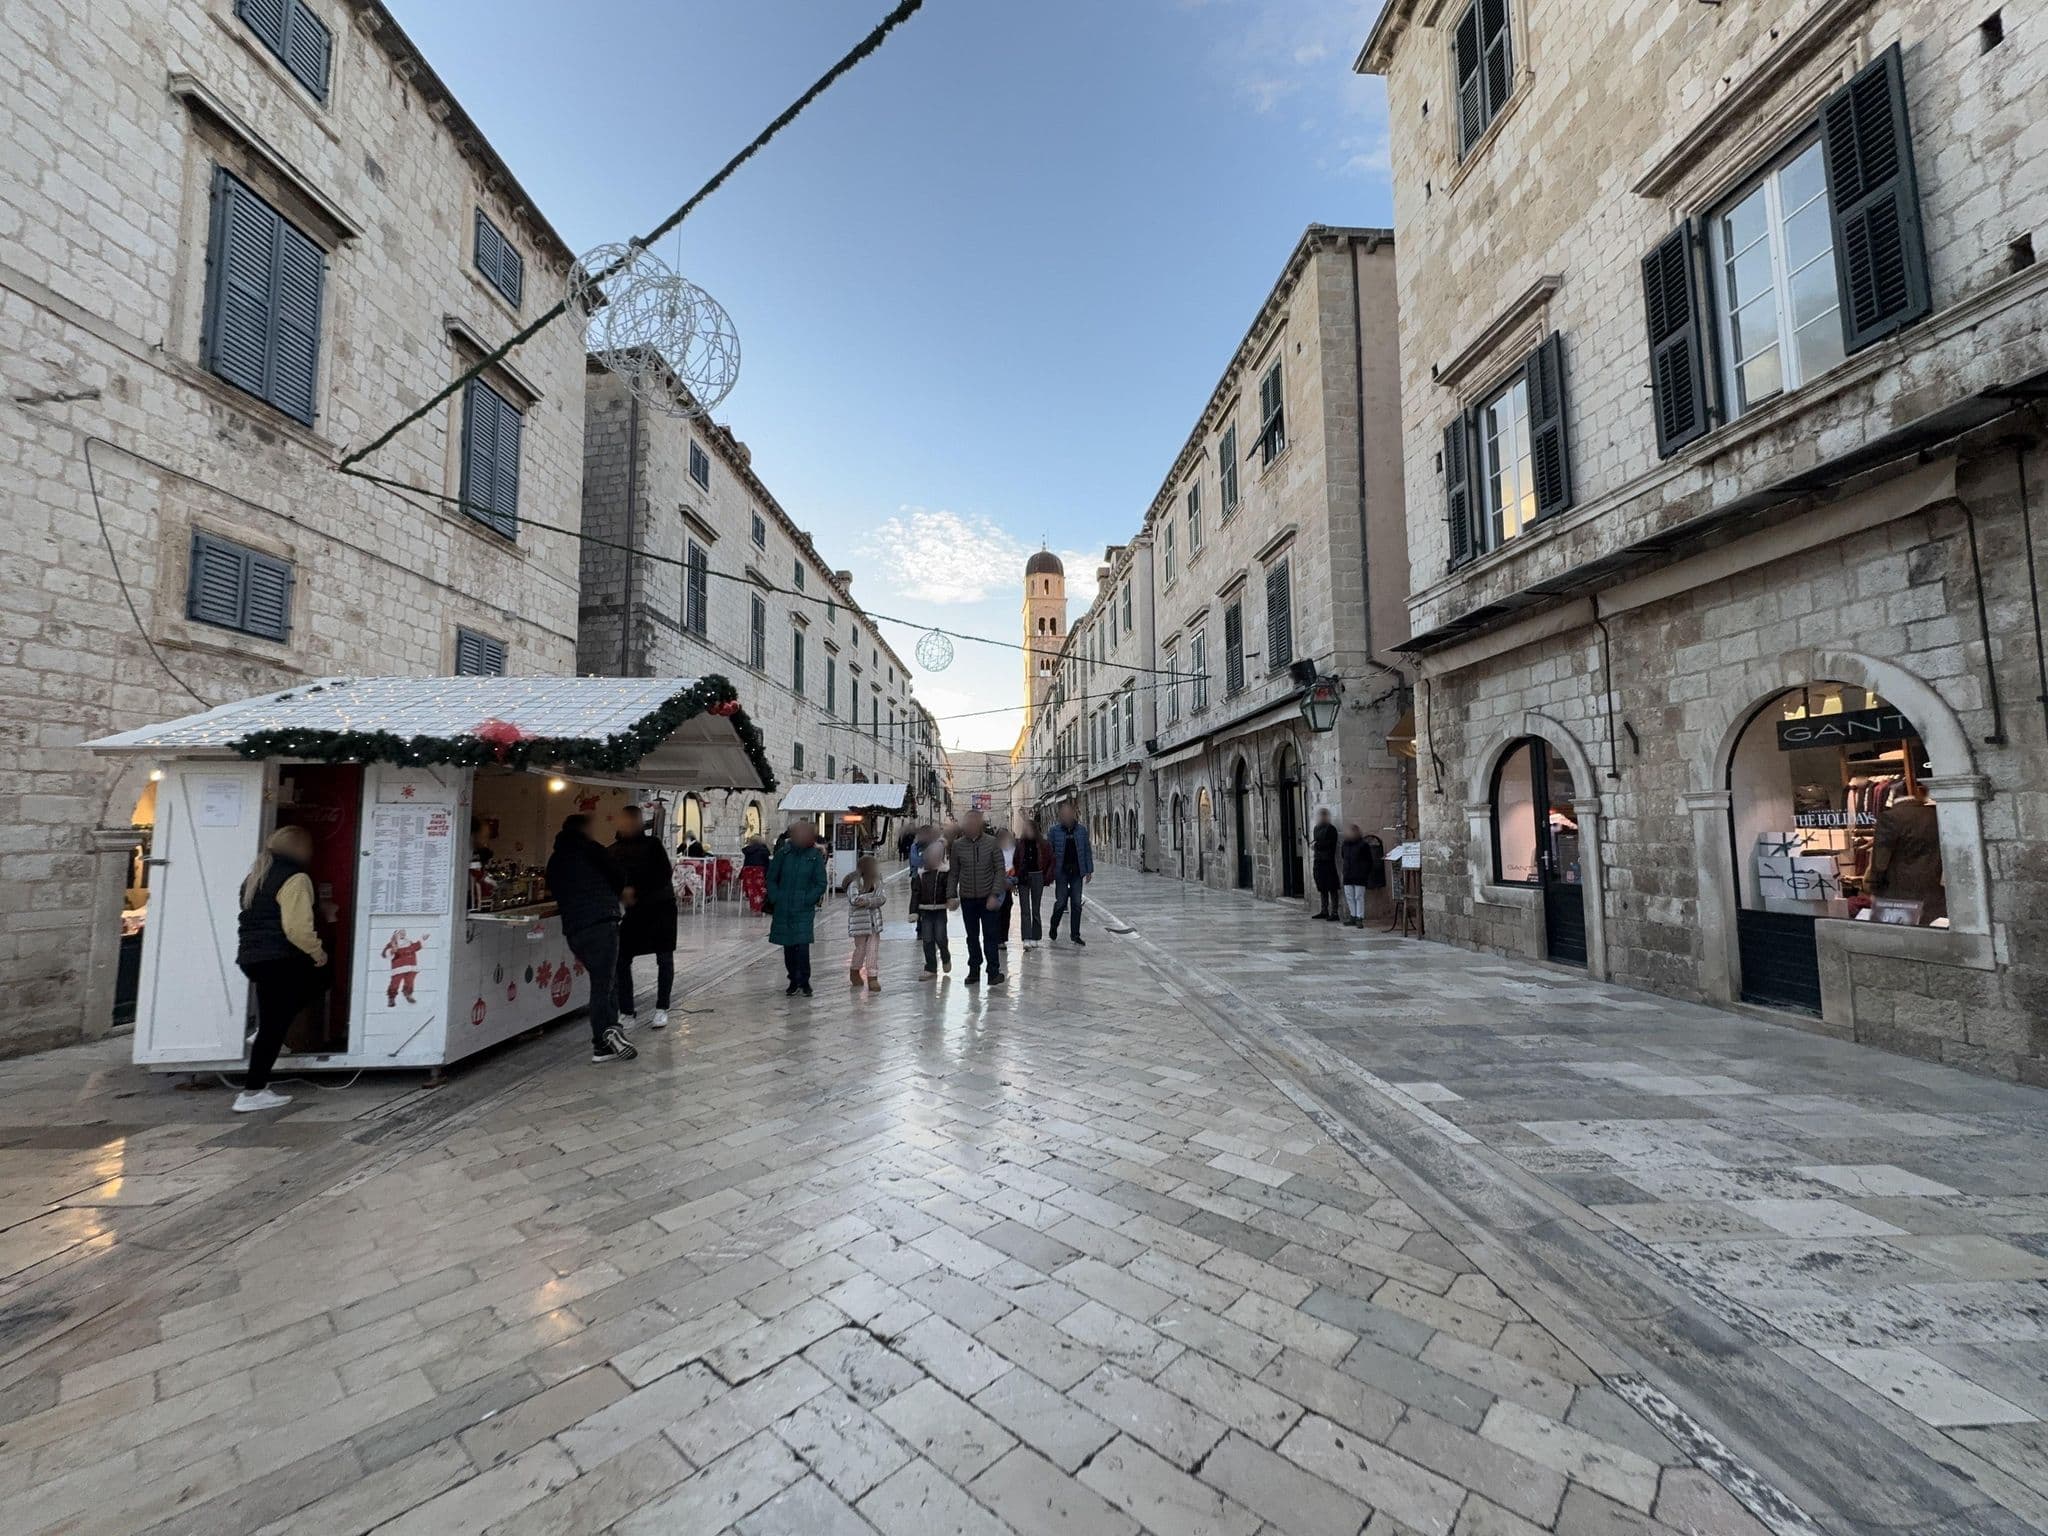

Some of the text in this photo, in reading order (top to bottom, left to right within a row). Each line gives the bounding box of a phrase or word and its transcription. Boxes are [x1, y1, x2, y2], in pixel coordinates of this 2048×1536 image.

[1783, 714, 1905, 741] GANT
[1791, 811, 1878, 827] THE HOLIDAYS
